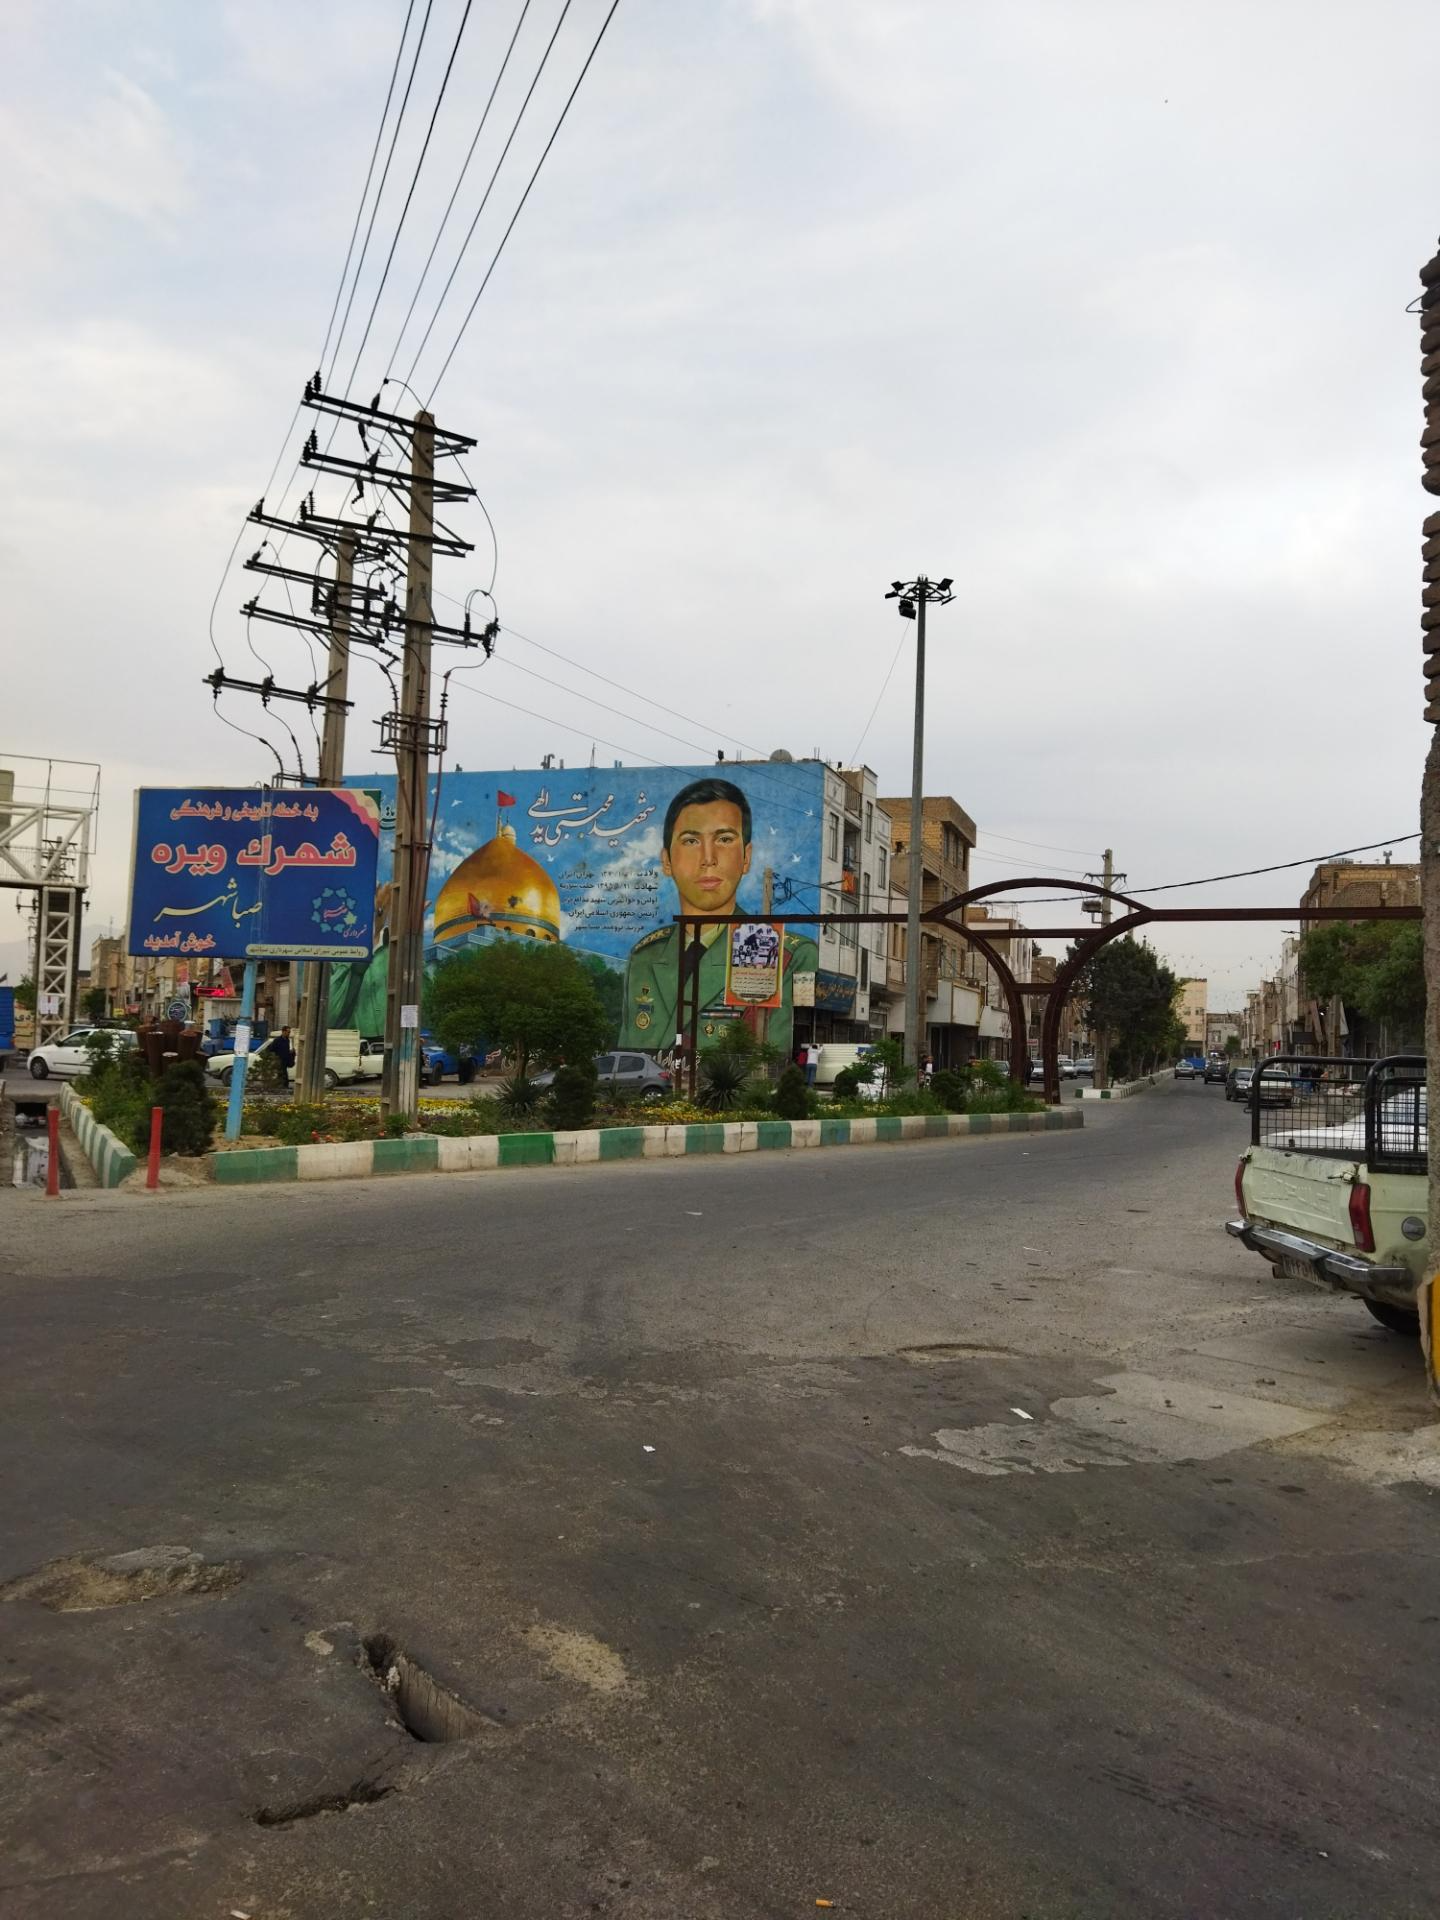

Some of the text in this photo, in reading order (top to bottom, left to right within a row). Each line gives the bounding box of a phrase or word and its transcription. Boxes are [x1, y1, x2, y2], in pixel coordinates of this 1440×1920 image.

[221, 806, 231, 821] و
[231, 801, 271, 821] تاریخی
[302, 803, 319, 823] به
[587, 791, 656, 847] شهید
[143, 930, 216, 952] خوش آمدید
